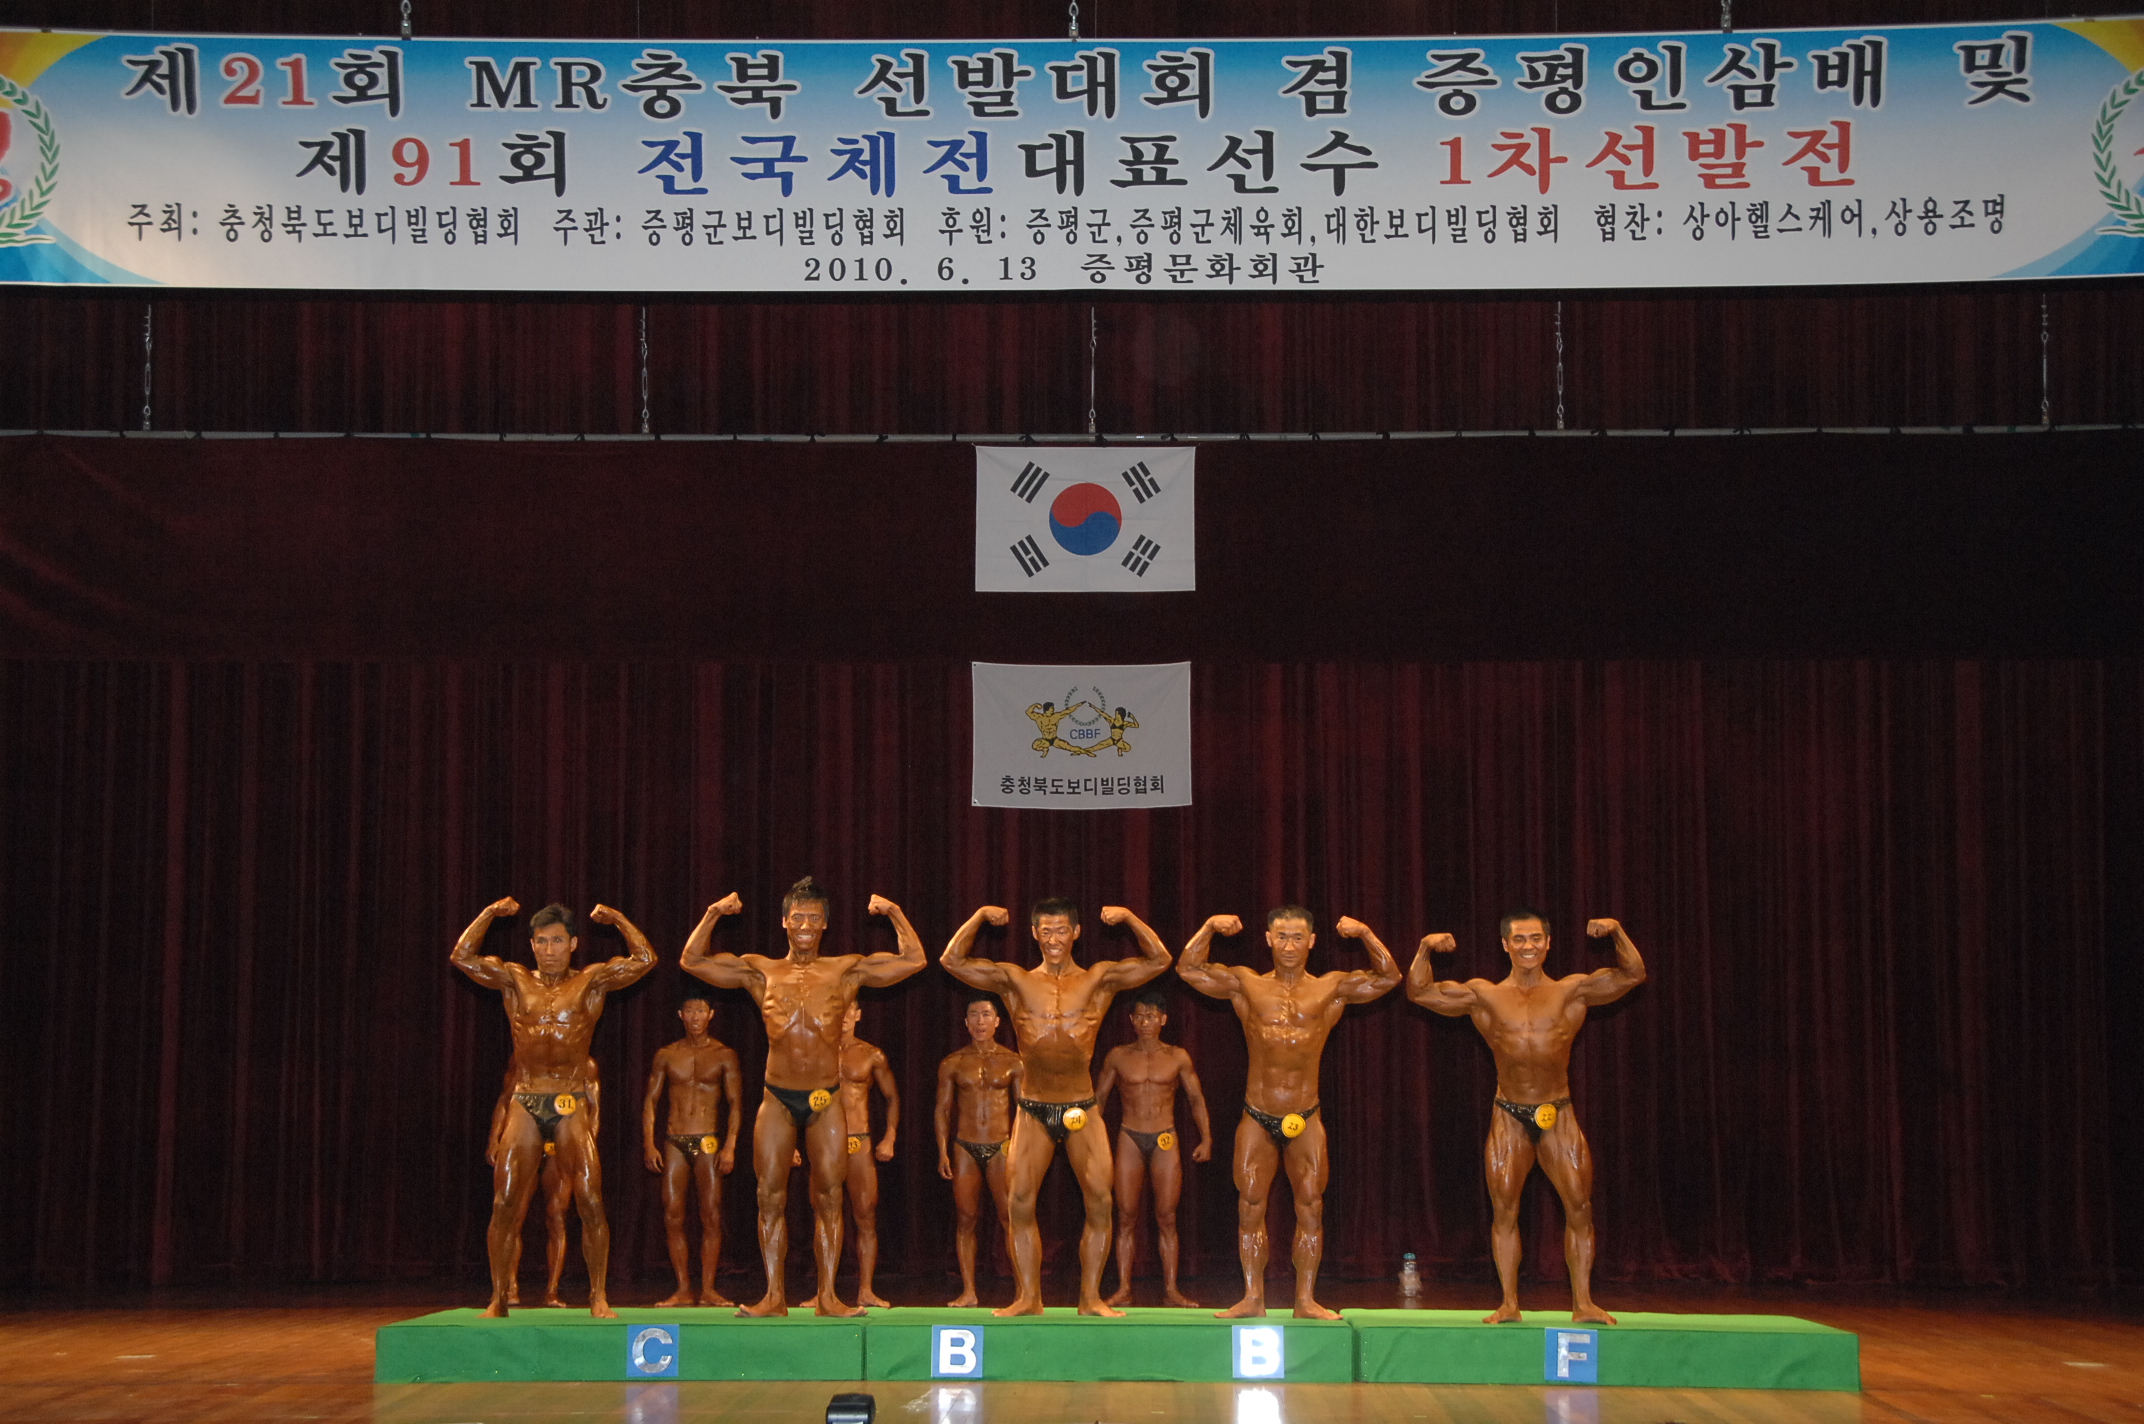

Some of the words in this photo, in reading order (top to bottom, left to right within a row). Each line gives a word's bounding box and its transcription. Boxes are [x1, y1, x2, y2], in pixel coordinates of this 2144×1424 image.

[124, 46, 401, 116] 제21회
[468, 52, 798, 120] MR충북
[857, 51, 1211, 119] 선발대회
[1282, 50, 1348, 118] 겸
[1415, 39, 1884, 116] 증평인삼배
[1959, 34, 2032, 105] 및
[295, 128, 566, 198] 제91회
[1439, 120, 1855, 195] 1차선발전
[127, 202, 198, 241] 주최:
[219, 203, 518, 246] 충청북도보디빌딩협회
[553, 207, 621, 247] 주관:
[641, 207, 904, 247] 증평군보디빌딩협회
[938, 206, 1006, 247] 후원:
[1594, 202, 1663, 243] 협찬:
[804, 257, 908, 285] 2010.
[937, 257, 969, 285] 6.
[999, 256, 1036, 281] 13
[1080, 252, 1325, 285] 증평문화회관
[1069, 728, 1101, 740] CBBF
[1000, 775, 1165, 796] 충청북도보디빌딩협회
[558, 1098, 574, 1110] 31
[813, 1096, 827, 1107] 25
[1287, 1121, 1299, 1131] 23
[632, 1328, 674, 1373] C
[938, 1329, 978, 1375] B
[1239, 1329, 1282, 1375] B
[1556, 1332, 1591, 1377] F
